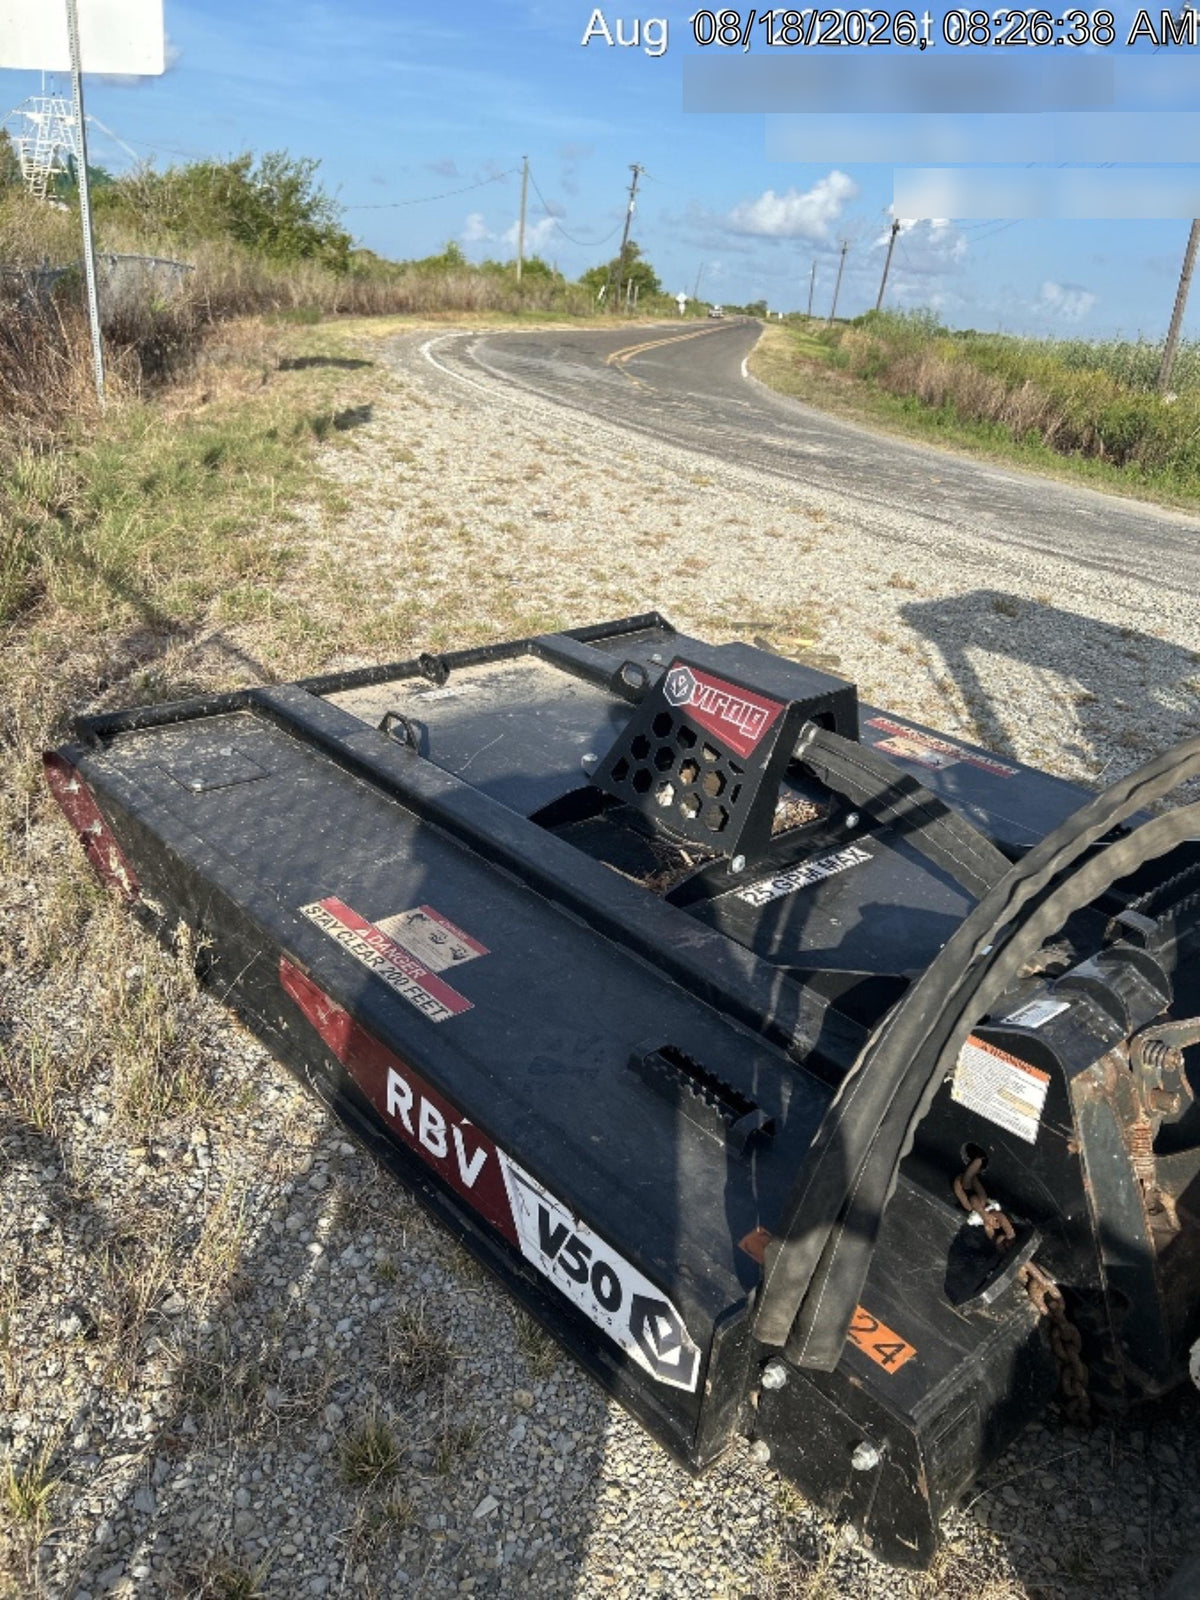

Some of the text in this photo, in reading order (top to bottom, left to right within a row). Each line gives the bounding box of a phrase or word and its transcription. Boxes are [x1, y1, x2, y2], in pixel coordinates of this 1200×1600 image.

[743, 885, 774, 903] 25
[818, 849, 868, 872] MAX
[306, 906, 344, 931] STAY
[337, 930, 385, 968] CLEAR
[379, 966, 409, 986] 200
[404, 986, 448, 1016] FEET
[367, 934, 428, 979] DANGER
[386, 1066, 488, 1188] RBV
[537, 1203, 622, 1313] V50
